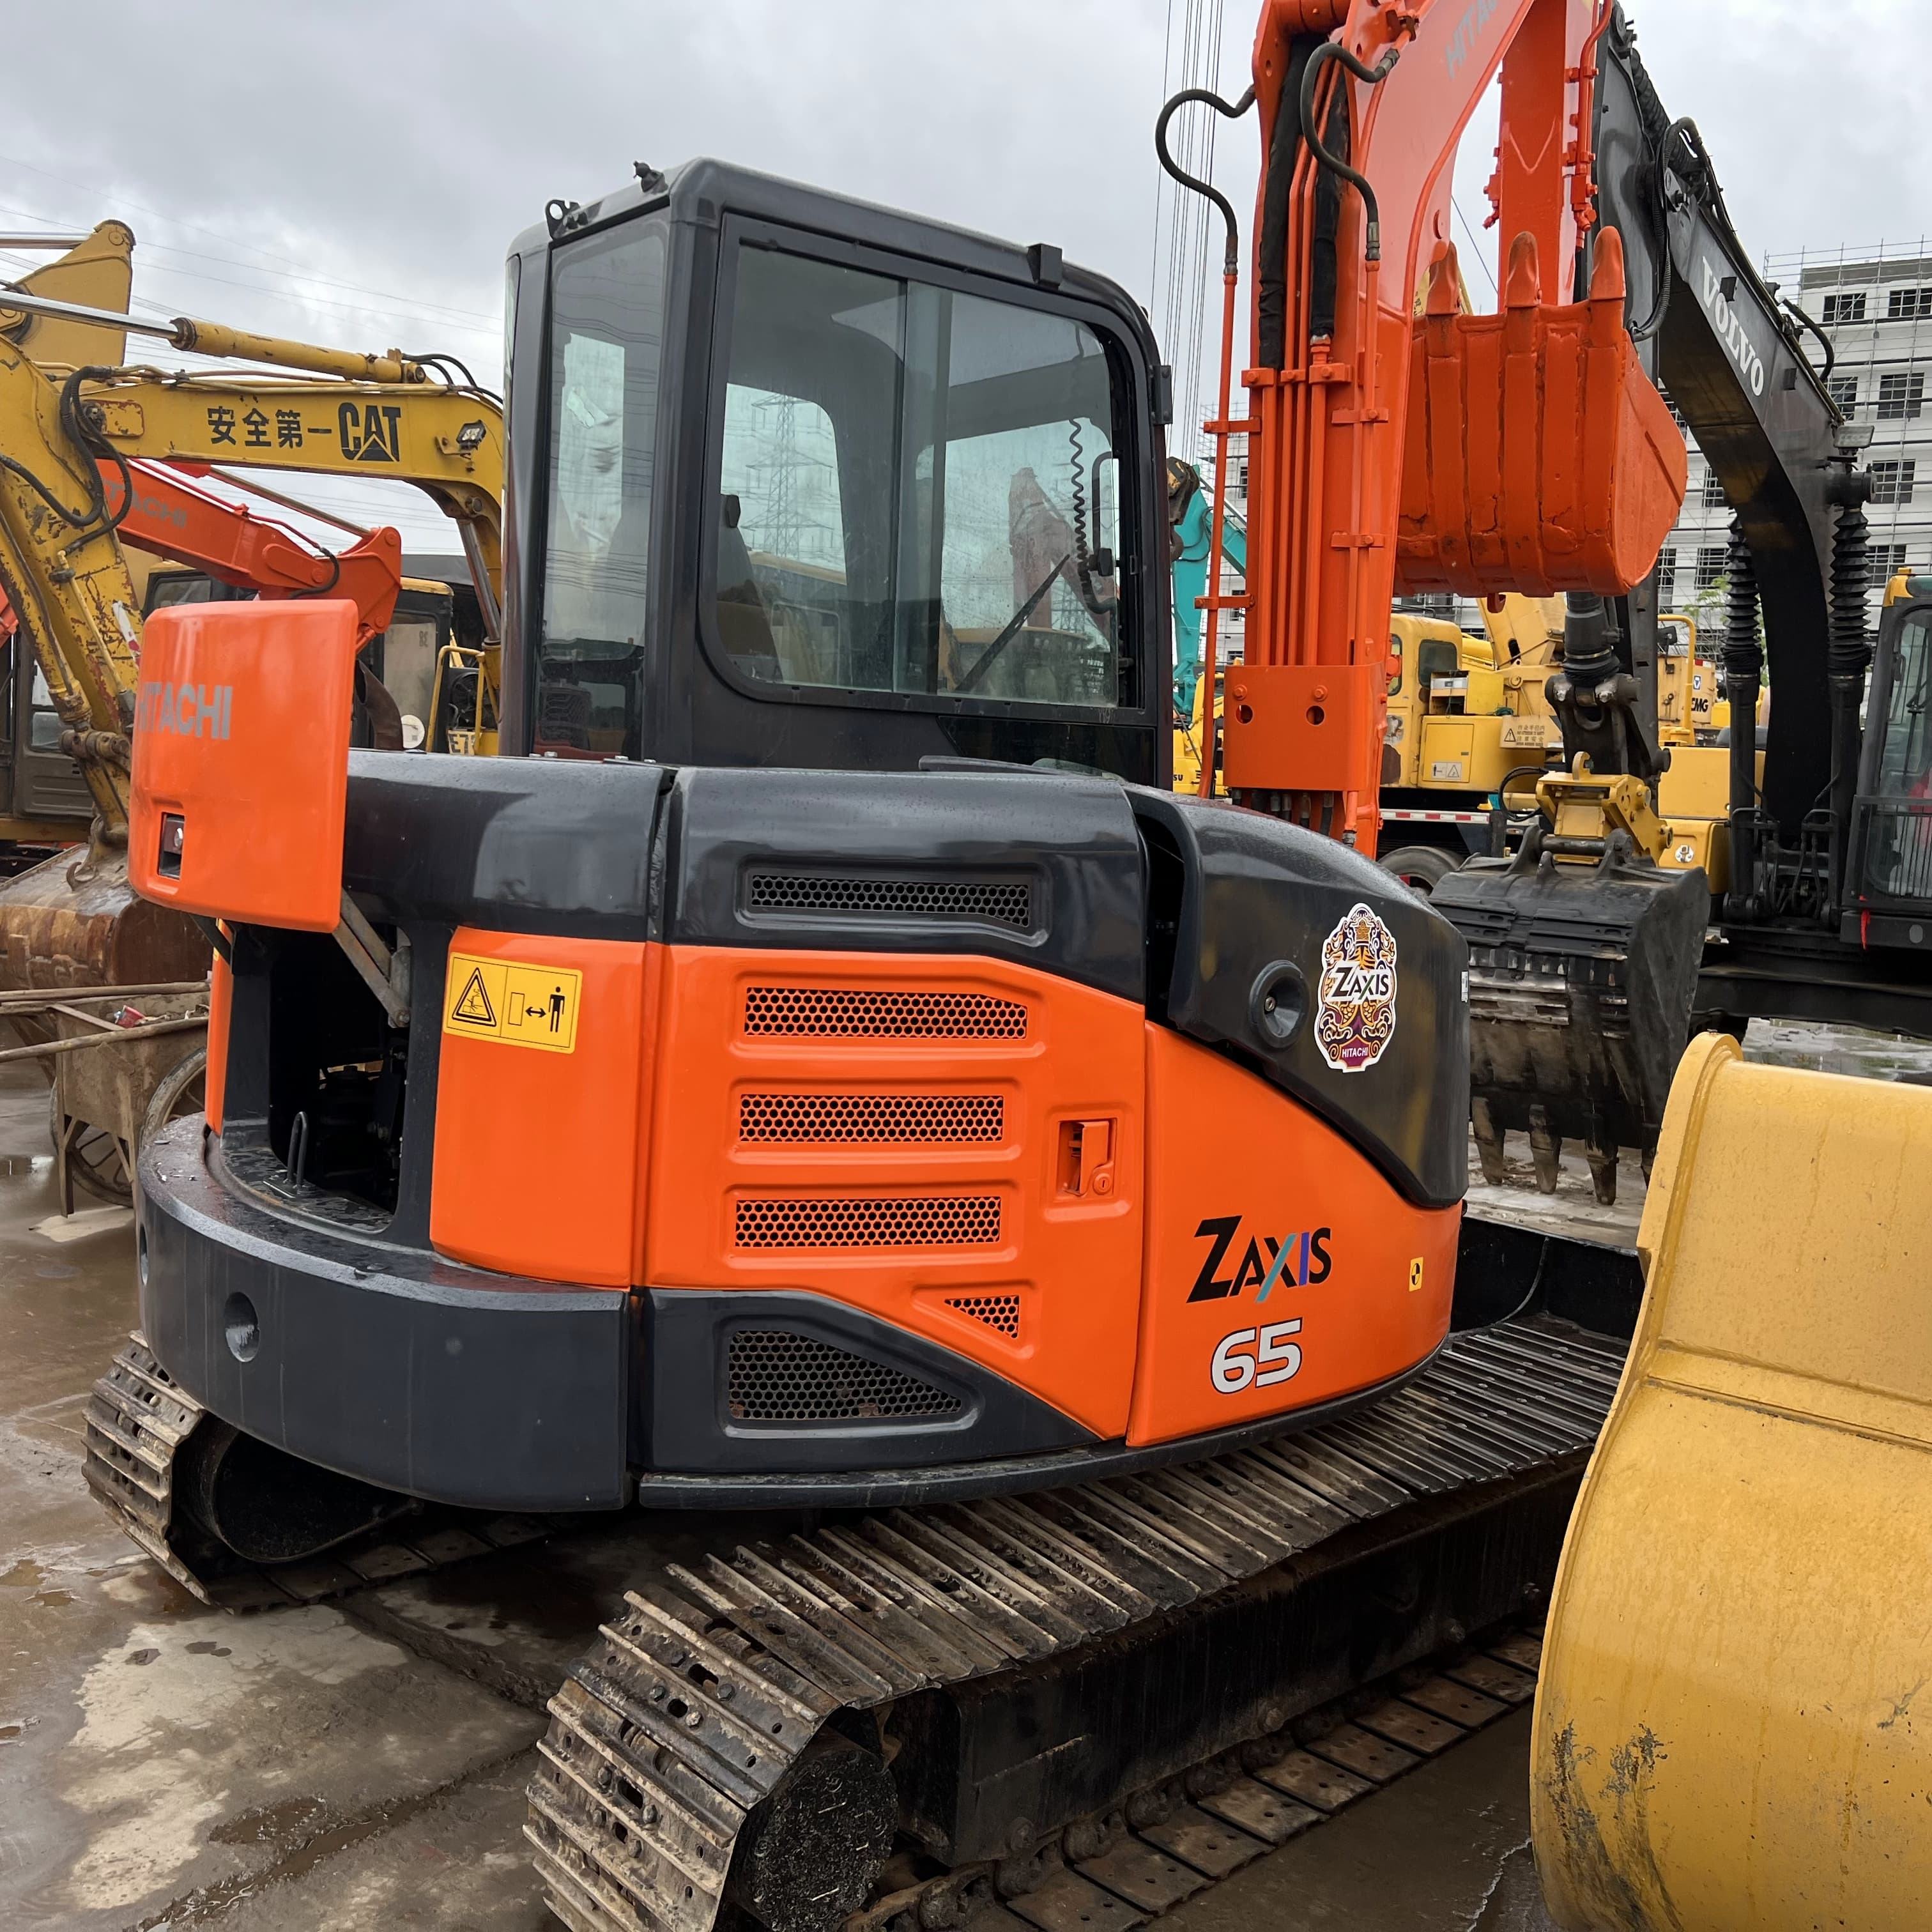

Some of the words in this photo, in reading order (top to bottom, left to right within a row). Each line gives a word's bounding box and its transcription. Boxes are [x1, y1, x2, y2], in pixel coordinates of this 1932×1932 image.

[1702, 256, 1764, 396] VOLVO
[207, 406, 332, 448] 安全第一
[338, 402, 402, 462] CAT
[1331, 967, 1390, 1000] ZAXIS
[1342, 1046, 1368, 1058] HITACHI
[1186, 1215, 1333, 1304] ZAXIS
[1210, 1317, 1303, 1395] 65
